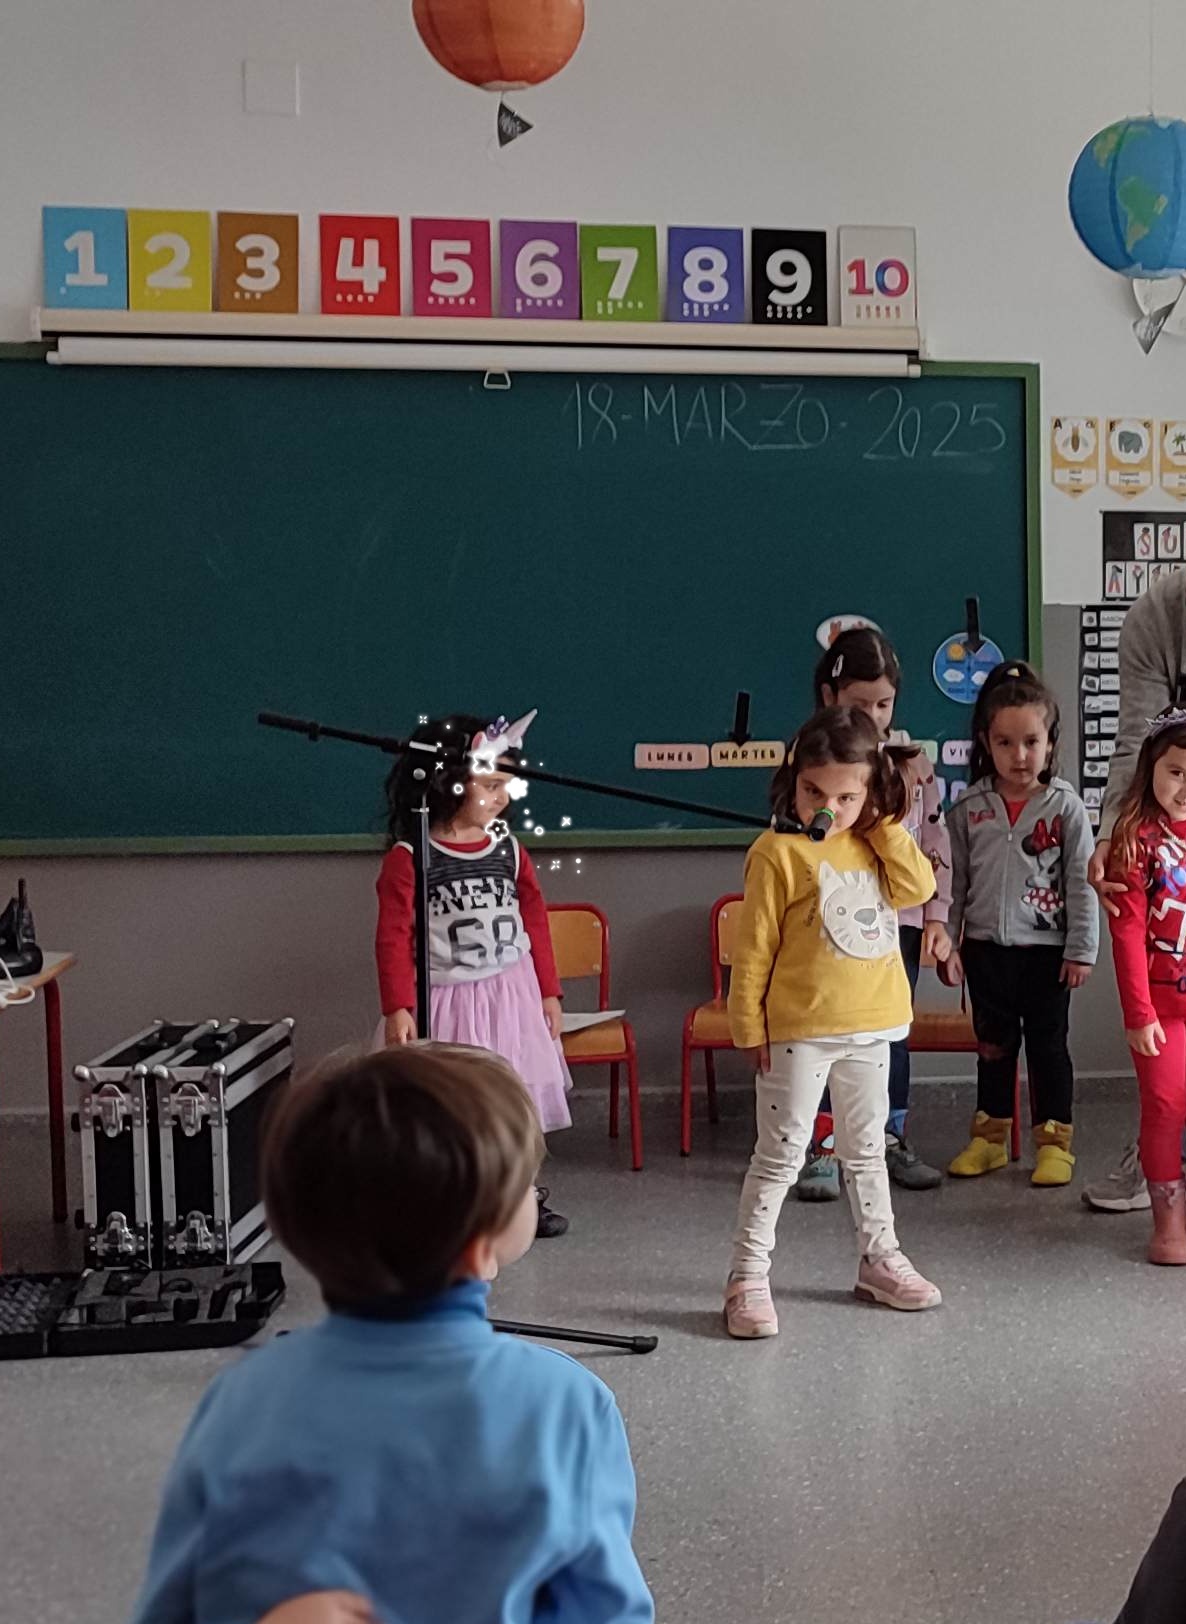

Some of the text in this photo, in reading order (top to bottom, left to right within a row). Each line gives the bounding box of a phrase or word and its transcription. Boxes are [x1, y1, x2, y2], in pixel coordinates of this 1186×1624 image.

[64, 230, 910, 305] 1 2 3 4 5 6 7 8 9 10
[719, 748, 776, 760] MARTES
[447, 914, 523, 969] 68
